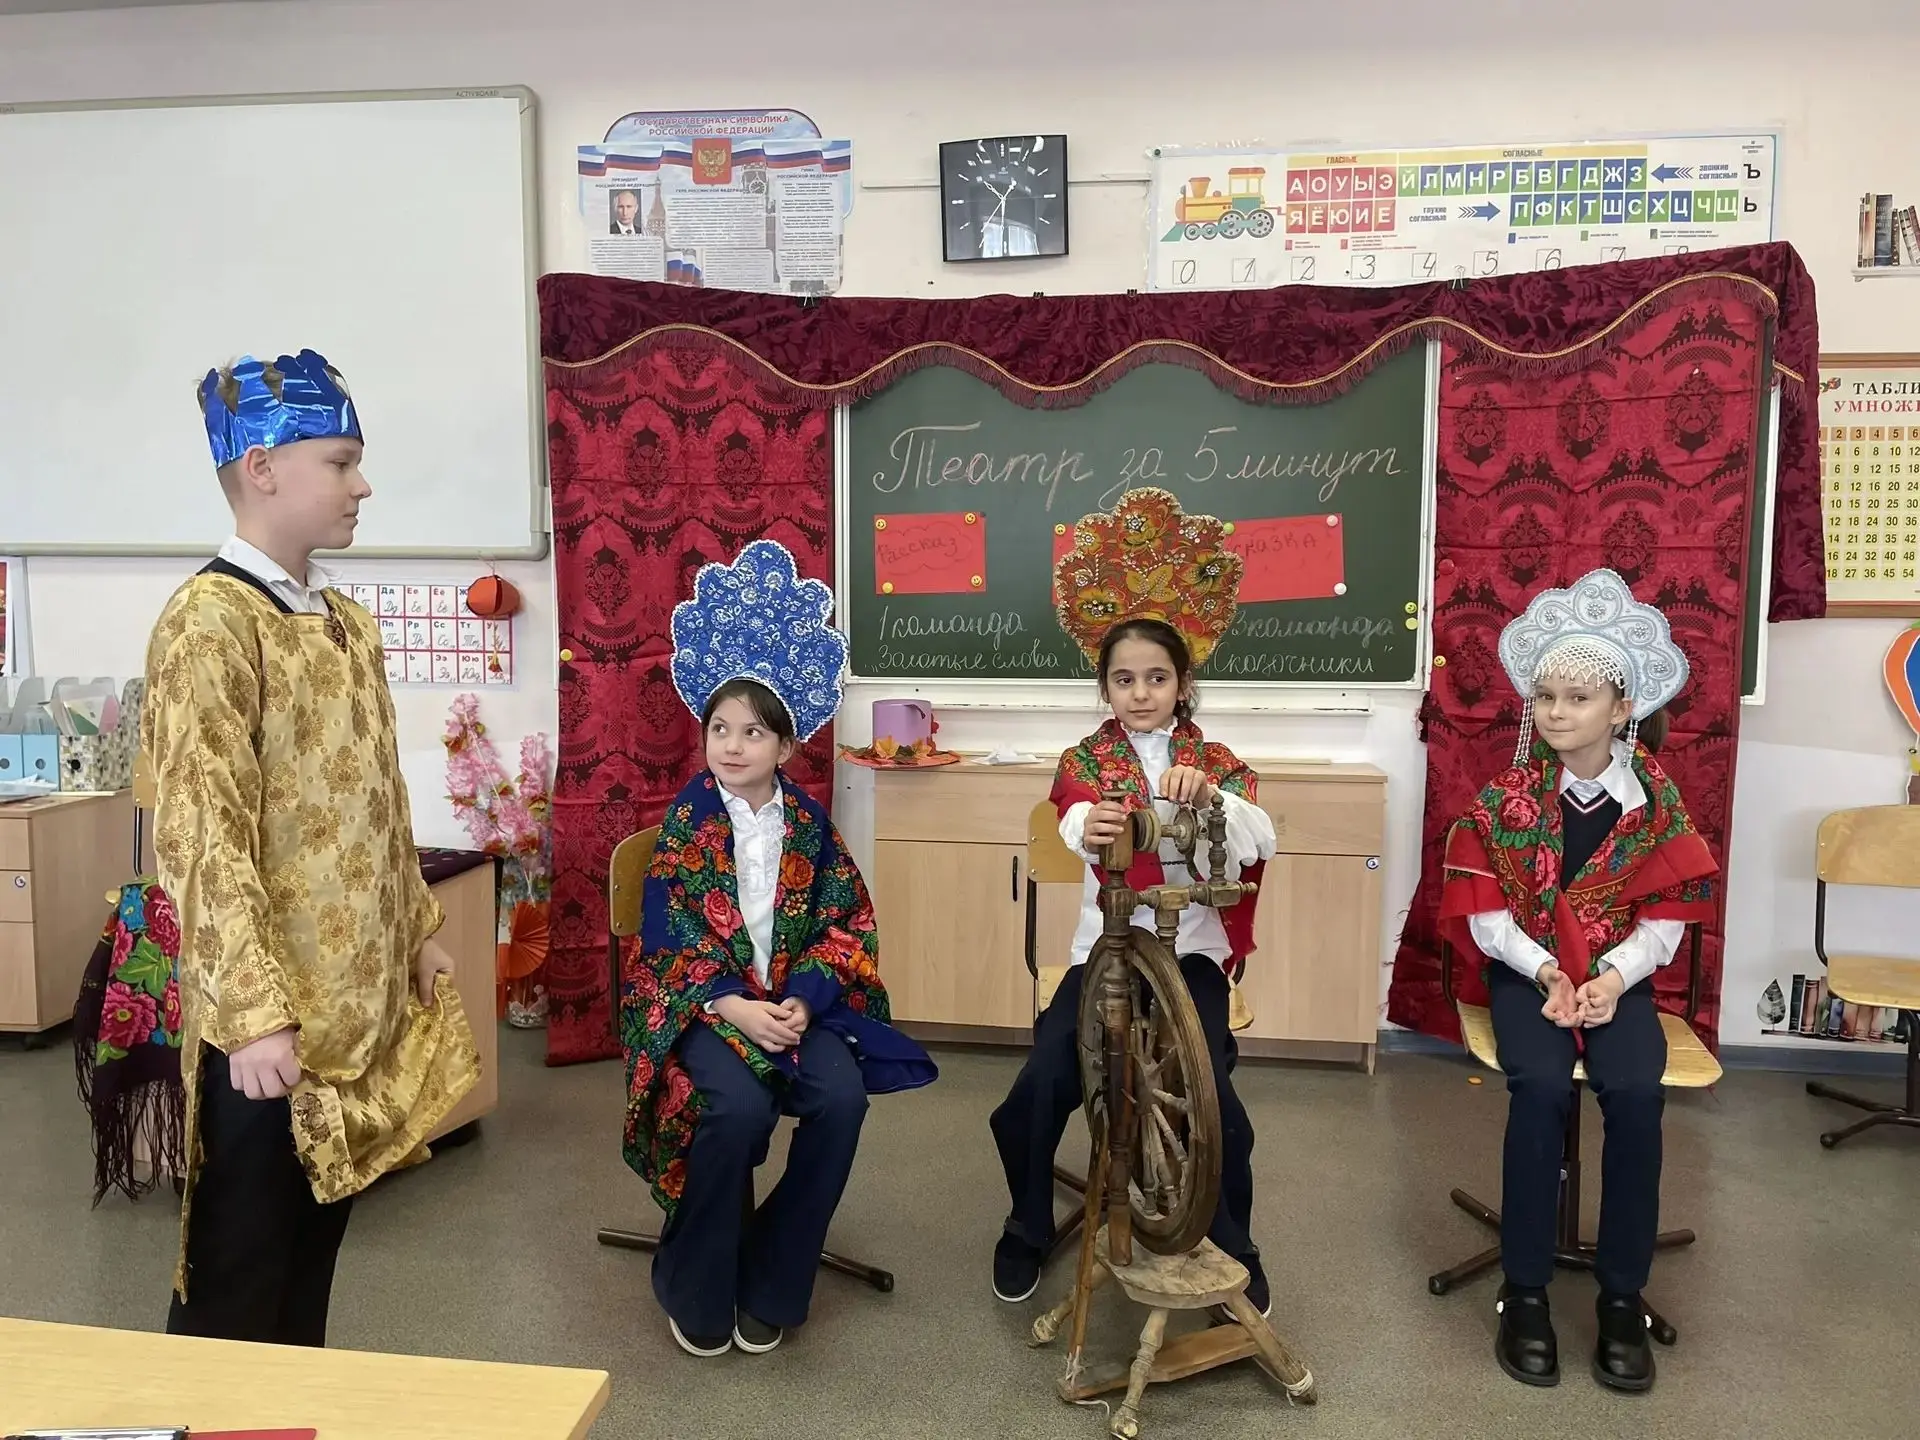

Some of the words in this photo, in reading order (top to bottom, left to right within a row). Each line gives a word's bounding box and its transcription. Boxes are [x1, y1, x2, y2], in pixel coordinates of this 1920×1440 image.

[633, 118, 728, 127] ГОСУДАРСТВЕННАЯ
[730, 115, 790, 124] СИМВОЛИКА
[649, 125, 713, 136] РОССИЙСКОЙ
[715, 126, 775, 135] ФЕДЕРАЦИИ
[1502, 149, 1543, 157] СОГЛАСНЫЕ
[1326, 156, 1358, 164] ГЛАСНЫЕ
[1180, 260, 1195, 284] 0
[1244, 258, 1256, 282] 1
[1300, 257, 1315, 281] 2
[1359, 255, 1375, 279] 3
[1423, 253, 1437, 277] 4
[1481, 250, 1499, 275] 5
[1544, 249, 1561, 270] 6
[1853, 382, 1920, 395] ТАБЛИ
[1836, 429, 1842, 438] 2
[1855, 429, 1862, 438] 3
[1874, 429, 1880, 438] 4
[1893, 429, 1899, 438] 5
[1912, 429, 1918, 438] 6
[1835, 447, 1840, 456] 4
[1854, 447, 1860, 456] 6
[1873, 447, 1879, 456] 8
[1890, 447, 1901, 456] 10
[1909, 447, 1920, 456] 12
[872, 420, 1094, 512] Театр
[1098, 448, 1167, 511] за
[1186, 426, 1238, 482] 5
[1226, 447, 1401, 503] минут
[1834, 464, 1840, 473] 6
[1853, 464, 1859, 473] 9
[1870, 464, 1881, 473] 12
[1890, 464, 1900, 473] 15
[1909, 464, 1920, 473] 18
[1833, 482, 1839, 491] 8
[1851, 482, 1861, 491] 12
[1870, 482, 1880, 491] 16
[1888, 482, 1900, 491] 20
[1907, 482, 1919, 491] 24
[1831, 499, 1841, 508] 10
[1849, 499, 1860, 508] 15
[1868, 499, 1879, 508] 20
[1887, 499, 1899, 508] 25
[1906, 499, 1918, 508] 30
[1830, 517, 1840, 526] 12
[1849, 517, 1859, 526] 18
[1867, 517, 1878, 526] 24
[1886, 517, 1898, 526] 30
[1905, 517, 1917, 526] 36
[1829, 534, 1839, 543] 14
[1847, 534, 1858, 543] 21
[1865, 534, 1877, 543] 28
[1885, 534, 1897, 543] 35
[1904, 534, 1916, 543] 42
[1828, 551, 1838, 560] 16
[1846, 551, 1857, 560] 24
[1865, 551, 1876, 560] 32
[1884, 551, 1896, 560] 40
[1903, 551, 1915, 560] 48
[1827, 569, 1837, 577] 18
[1845, 569, 1856, 577] 27
[1864, 569, 1876, 577] 36
[1883, 569, 1895, 577] 45
[1902, 569, 1914, 577] 54
[892, 611, 1028, 650] команда
